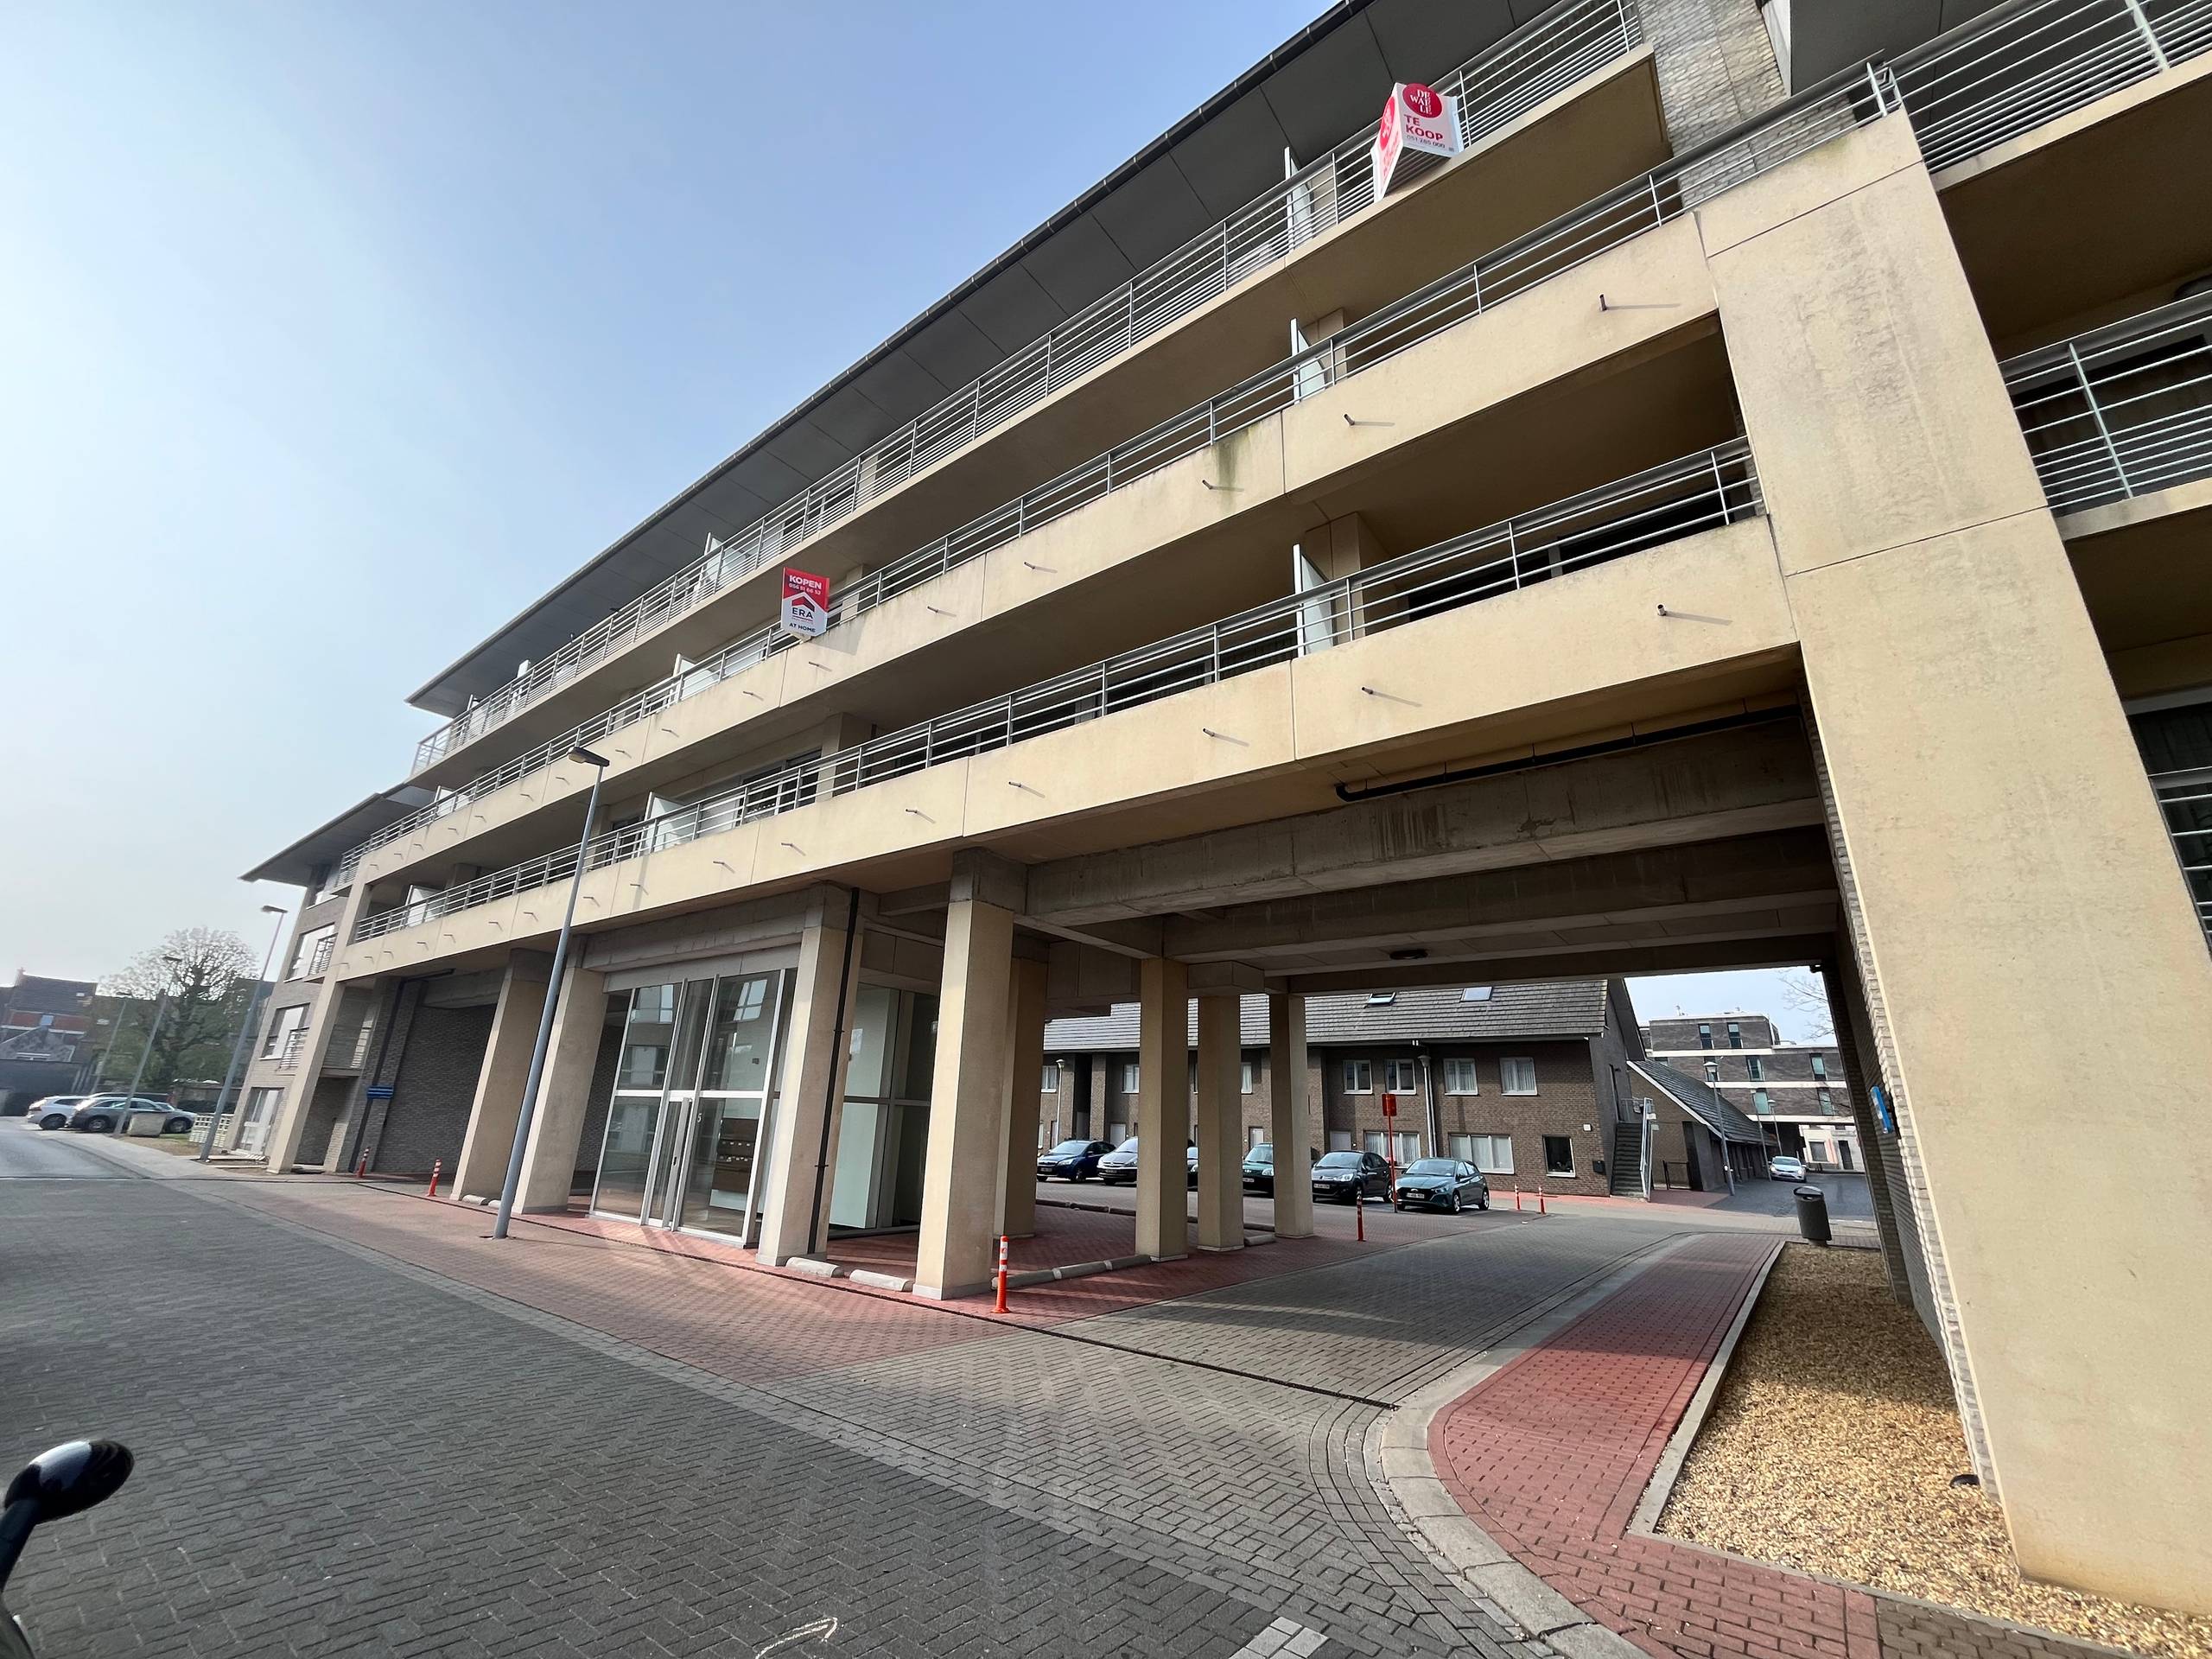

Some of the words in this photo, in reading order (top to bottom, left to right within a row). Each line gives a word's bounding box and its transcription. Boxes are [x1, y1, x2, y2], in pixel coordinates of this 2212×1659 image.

[1404, 114, 1420, 126] TE
[1406, 124, 1443, 140] KOOP
[789, 575, 822, 589] KOPEN
[791, 607, 813, 619] ERA
